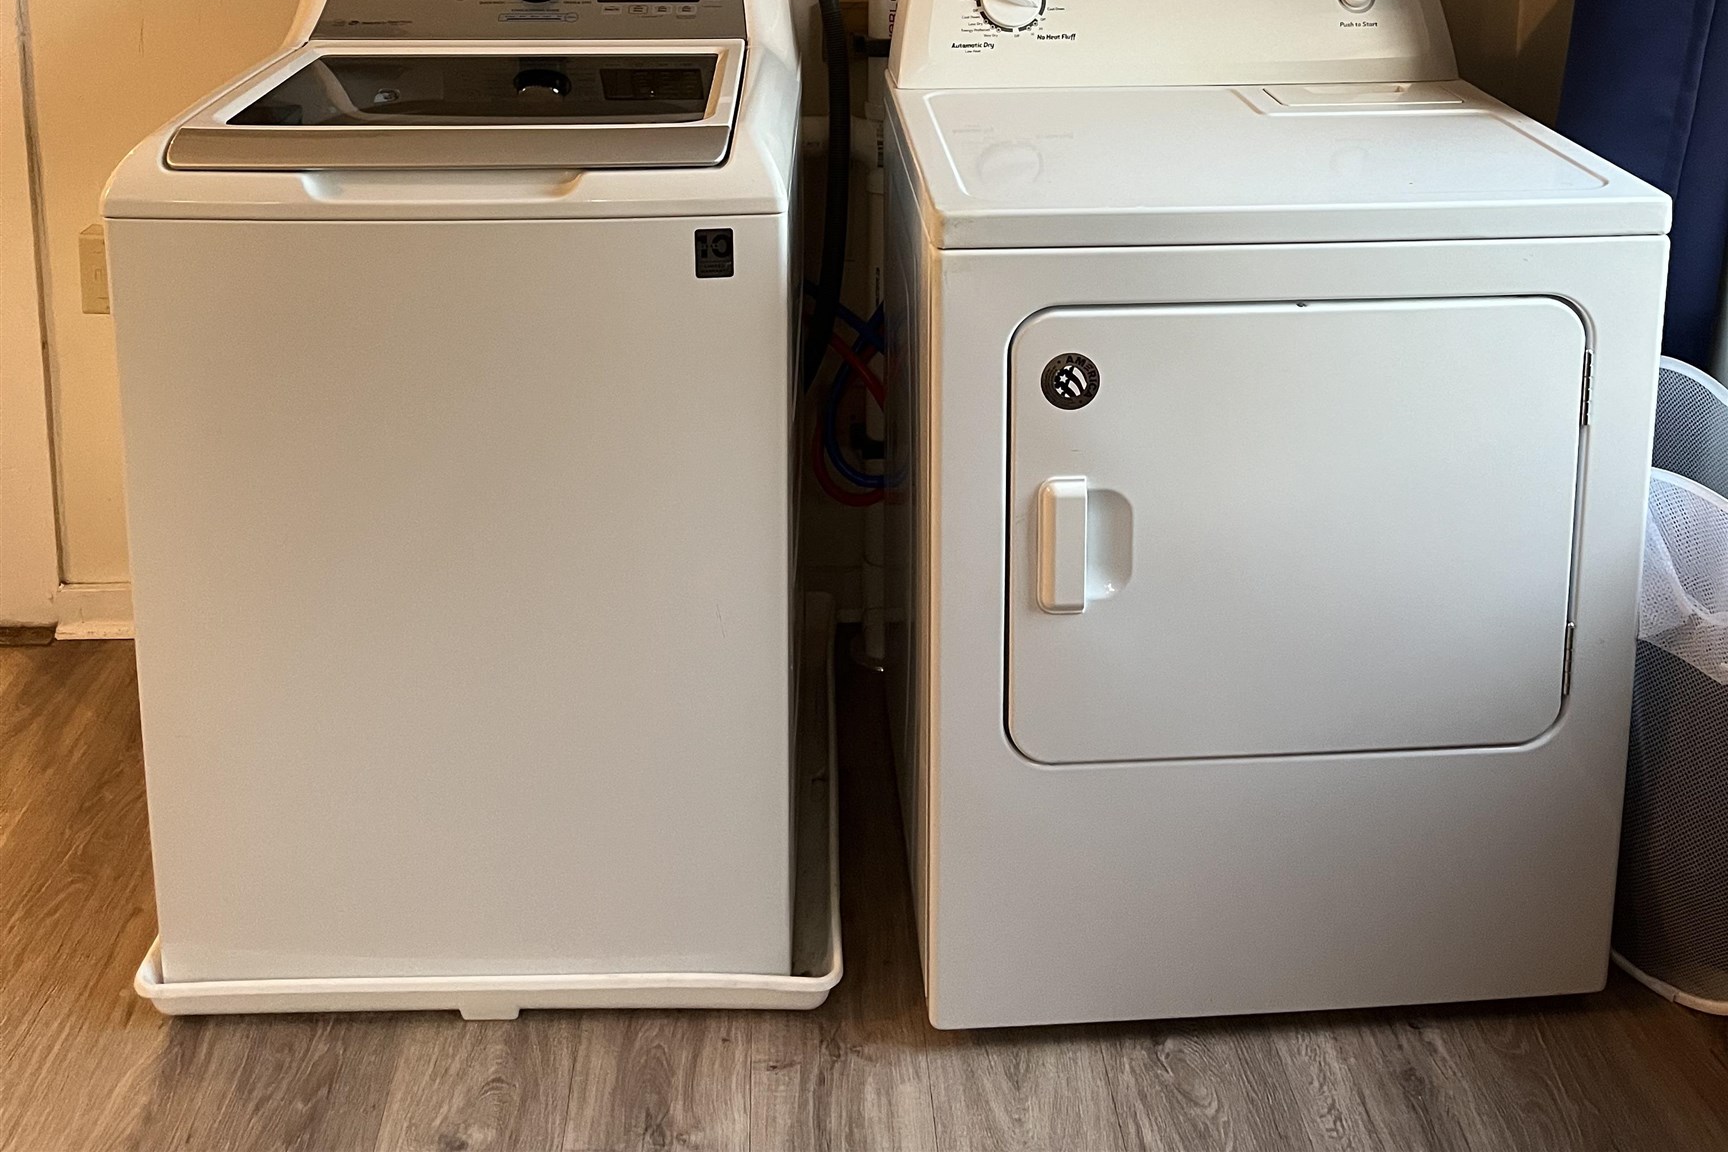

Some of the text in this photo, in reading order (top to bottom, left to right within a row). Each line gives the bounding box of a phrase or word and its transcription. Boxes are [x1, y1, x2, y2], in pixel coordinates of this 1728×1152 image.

[1061, 32, 1076, 41] Fluff
[983, 42, 995, 50] Dry
[1065, 355, 1098, 398] AMERICA
